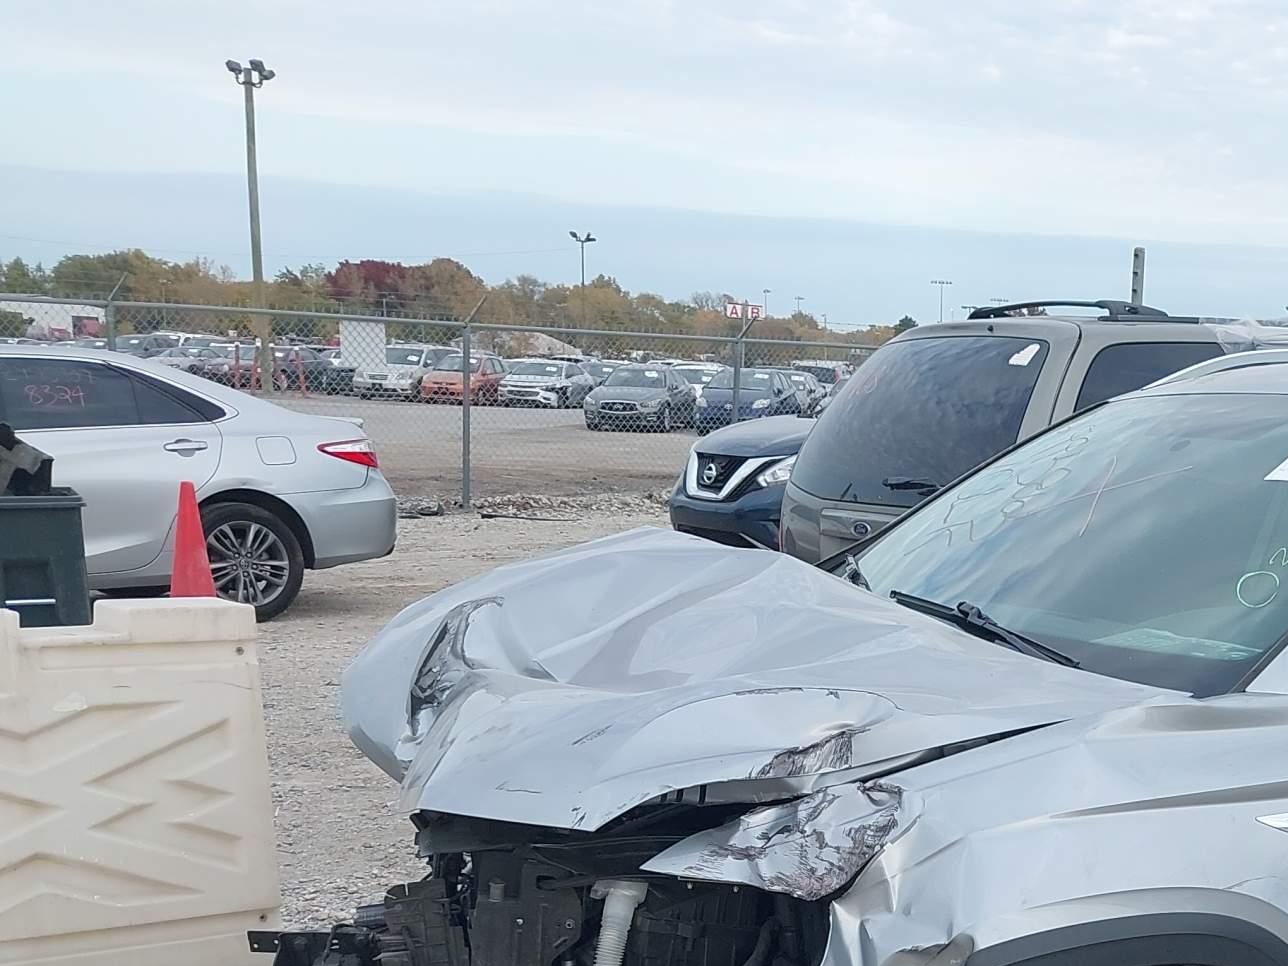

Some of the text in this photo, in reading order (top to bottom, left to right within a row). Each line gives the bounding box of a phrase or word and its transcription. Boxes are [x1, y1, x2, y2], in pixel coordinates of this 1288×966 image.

[730, 305, 739, 318] A
[751, 307, 760, 319] B
[24, 384, 86, 408] 8324
